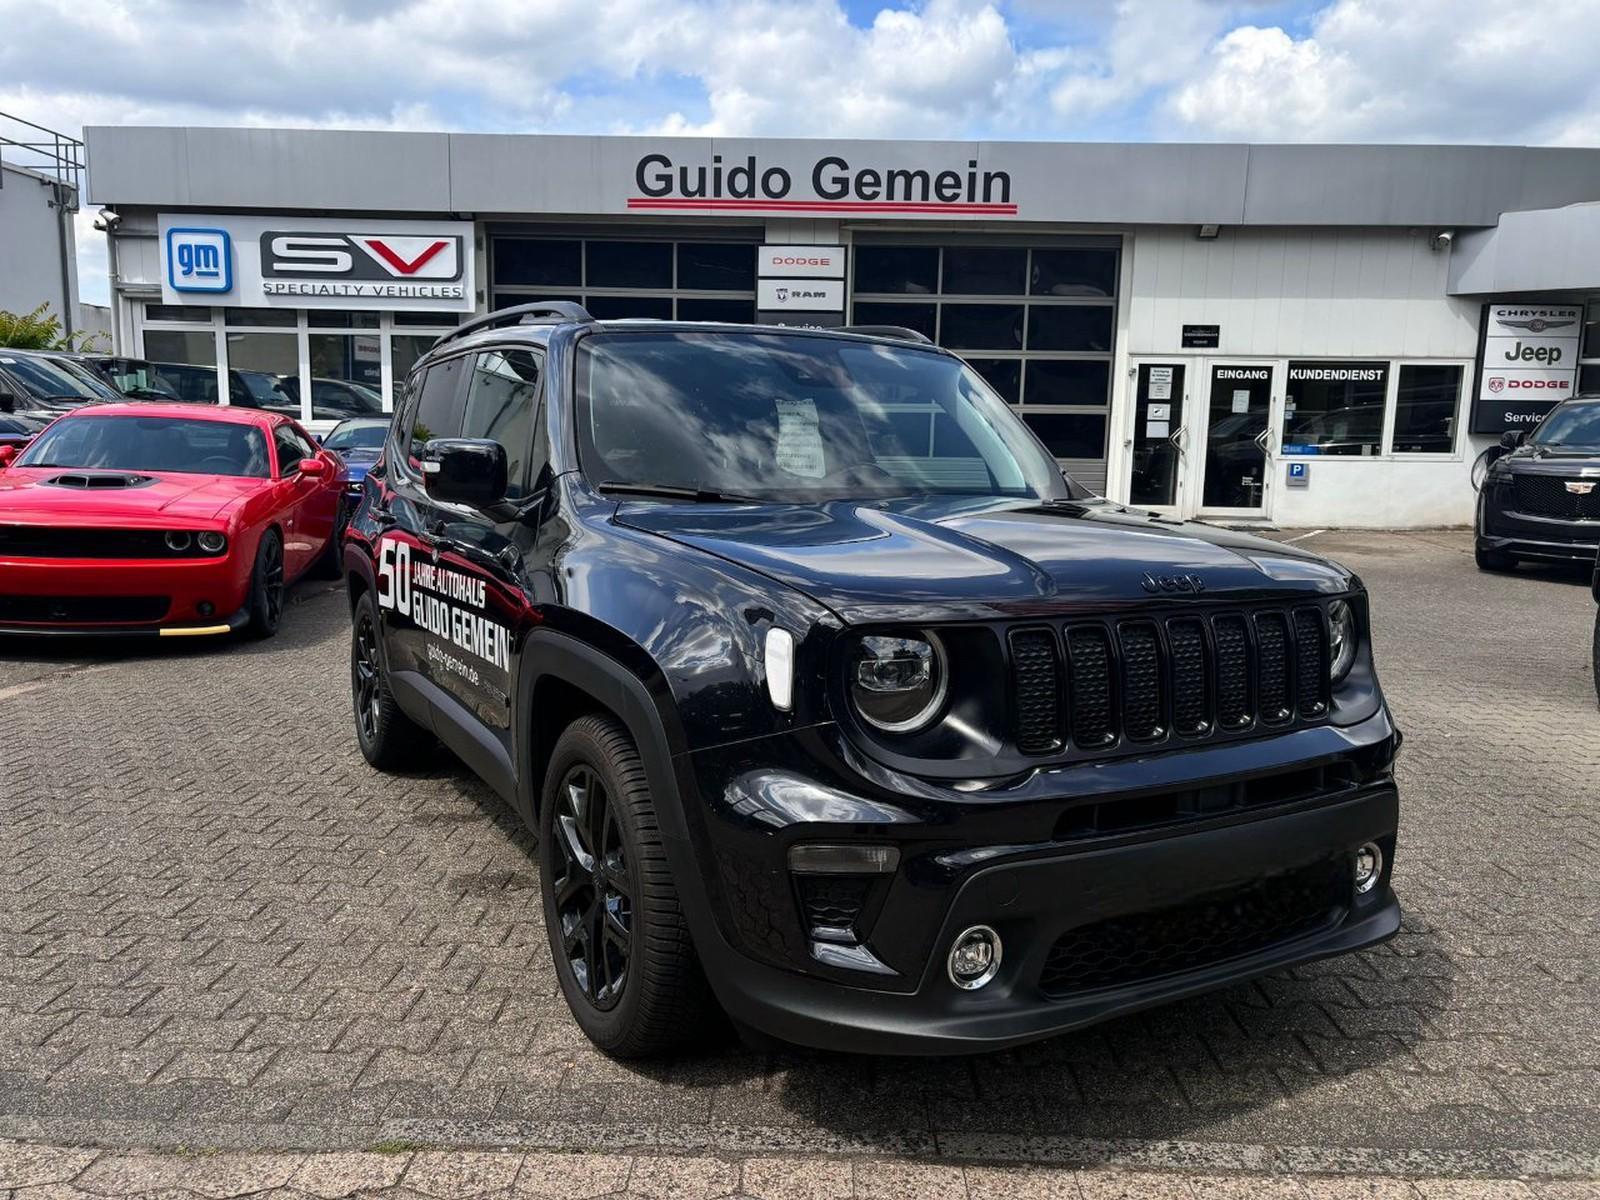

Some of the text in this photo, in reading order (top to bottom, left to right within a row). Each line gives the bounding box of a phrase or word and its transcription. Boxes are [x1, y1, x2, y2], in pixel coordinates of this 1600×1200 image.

[635, 153, 1011, 203] Guido Gemein
[178, 243, 219, 276] gm
[271, 236, 450, 274] SV
[772, 257, 831, 266] DODGE
[263, 282, 462, 298] SPECIALTY VEHICLES
[1496, 309, 1577, 317] CHRYSLER
[1505, 341, 1562, 365] Jeep
[1217, 369, 1268, 380] EINGANG
[1289, 369, 1384, 381] KUNDENDIENST
[1508, 380, 1570, 389] DODGE
[1504, 411, 1547, 423] Servic
[1293, 464, 1302, 475] P
[378, 538, 411, 616] 50
[412, 561, 486, 609] JAHRE AUTOHAUS
[412, 590, 511, 673] GUIDO GEMEIN
